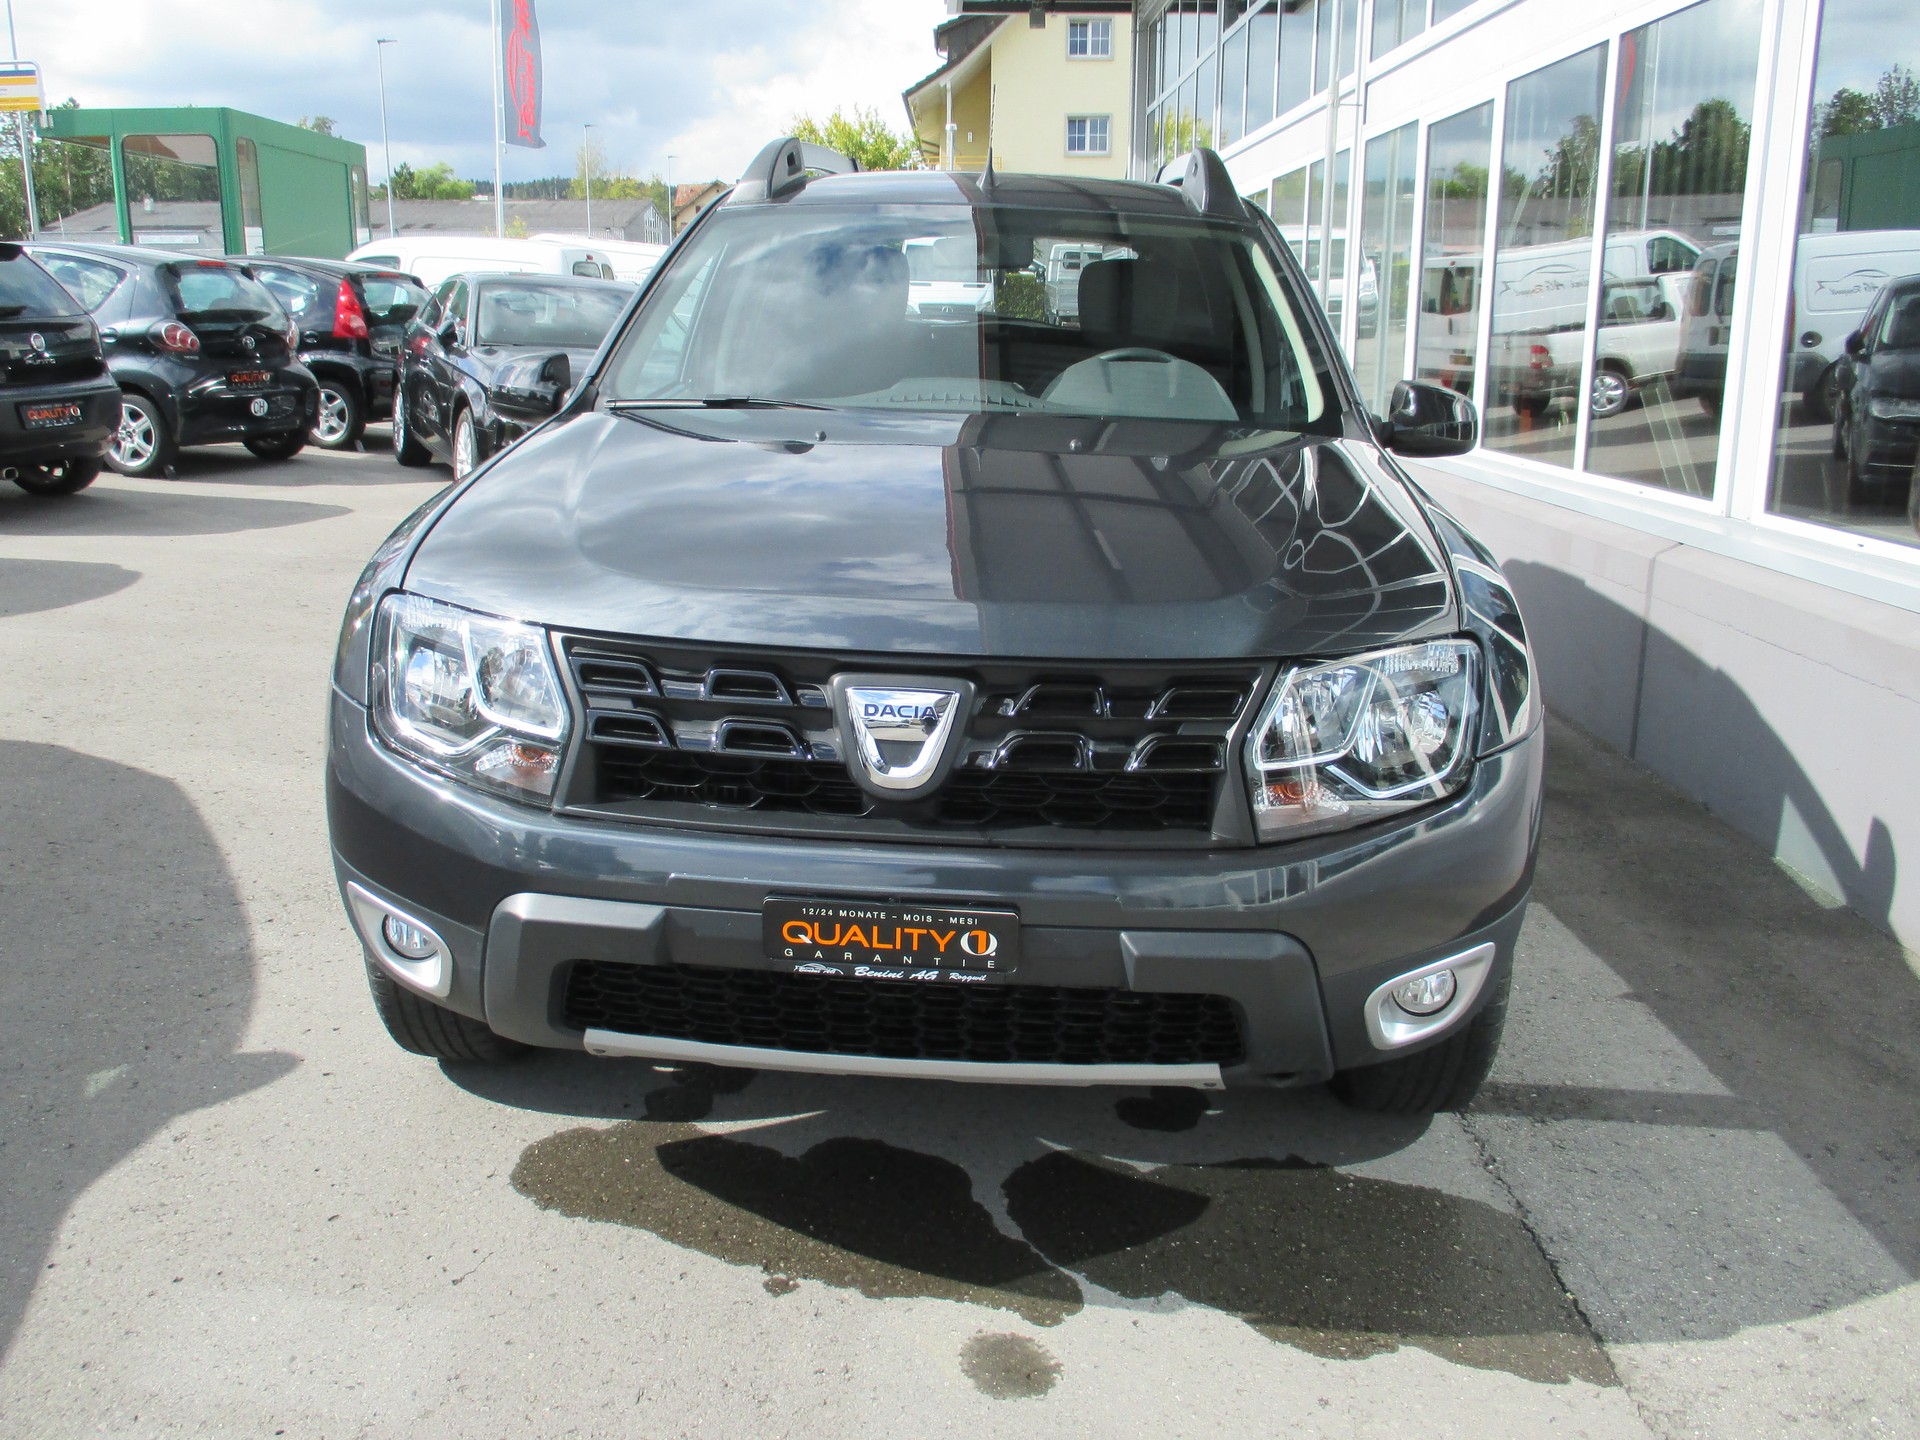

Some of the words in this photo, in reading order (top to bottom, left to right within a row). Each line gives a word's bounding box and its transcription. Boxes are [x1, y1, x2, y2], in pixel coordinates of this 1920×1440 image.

[27, 407, 70, 420] QUALITY
[253, 401, 265, 414] CH
[864, 703, 937, 719] DACIA
[802, 908, 833, 916] 12/24
[839, 910, 886, 919] MONATE
[903, 914, 932, 923] MOIS
[949, 917, 978, 925] MESI
[782, 920, 957, 953] QUALITY
[784, 948, 995, 969] GARANTIE
[854, 966, 904, 979] Benini
[909, 969, 940, 980] AG
